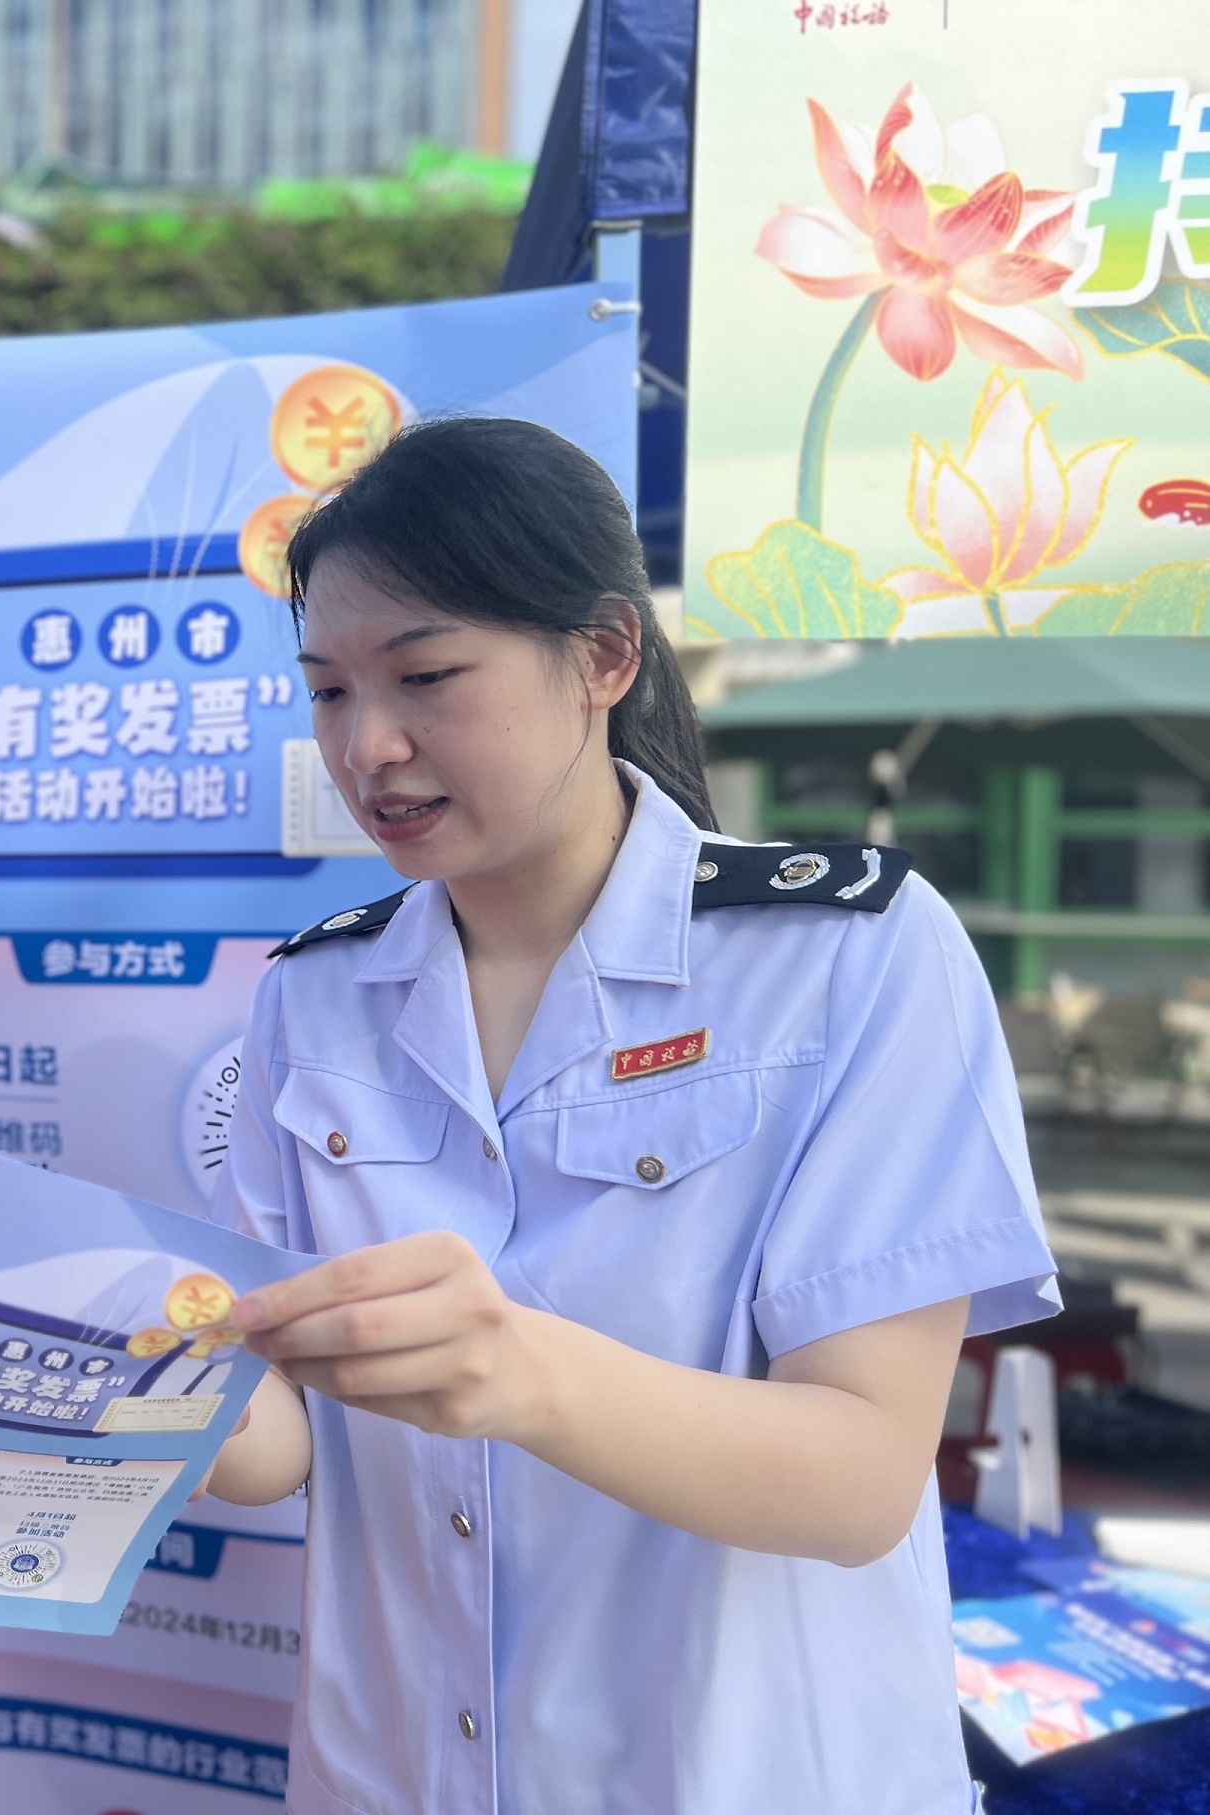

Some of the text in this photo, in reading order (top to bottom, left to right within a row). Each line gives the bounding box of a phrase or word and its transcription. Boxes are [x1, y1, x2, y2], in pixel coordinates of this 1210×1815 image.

[32, 610, 228, 665] 惠州市
[42, 940, 185, 978] 参与方式
[1, 1340, 111, 1373] 惠州市
